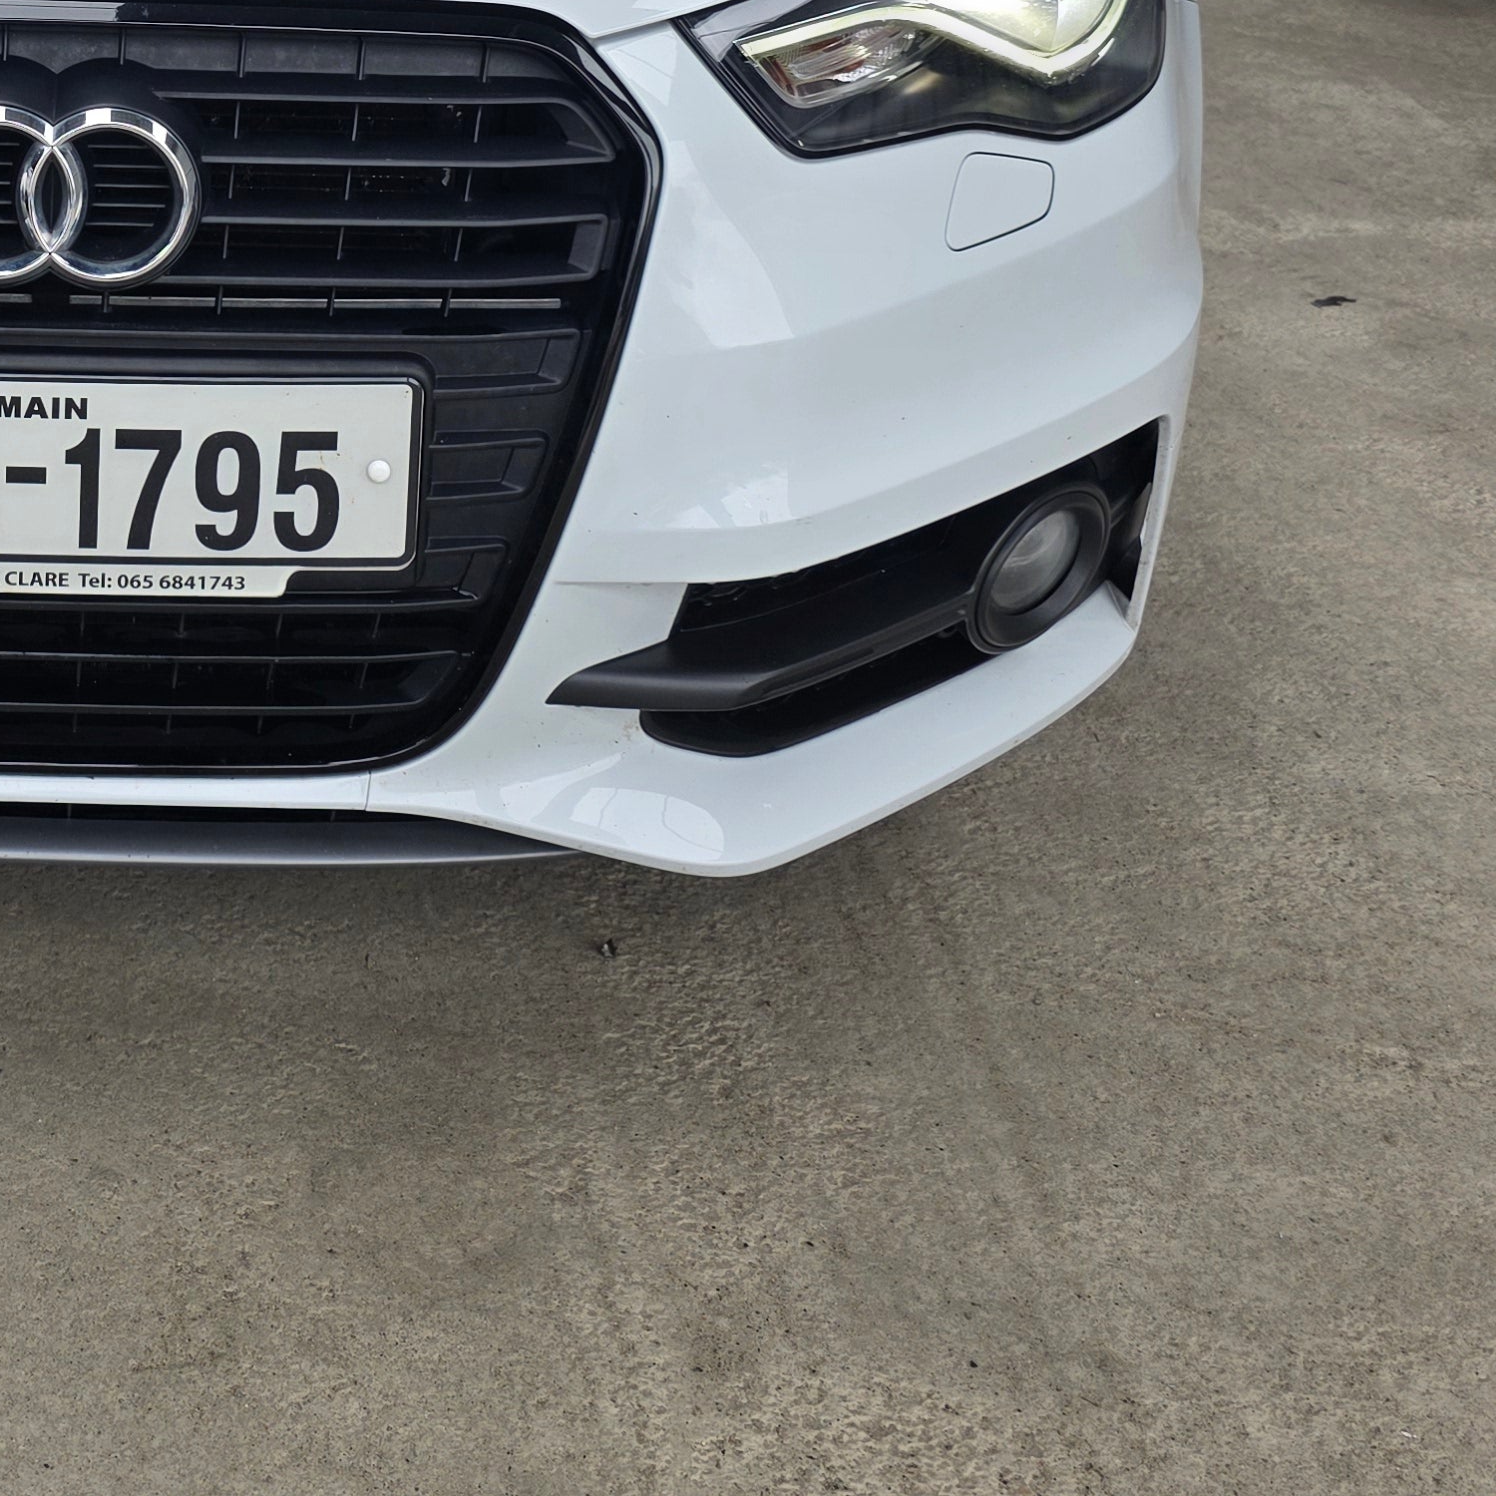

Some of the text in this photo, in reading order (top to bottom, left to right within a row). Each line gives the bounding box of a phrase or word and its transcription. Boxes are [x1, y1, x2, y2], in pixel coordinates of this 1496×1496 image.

[4, 571, 69, 588] CLARE
[79, 573, 112, 588] Tel:
[117, 574, 153, 589] 065
[159, 575, 246, 590] 6841743
